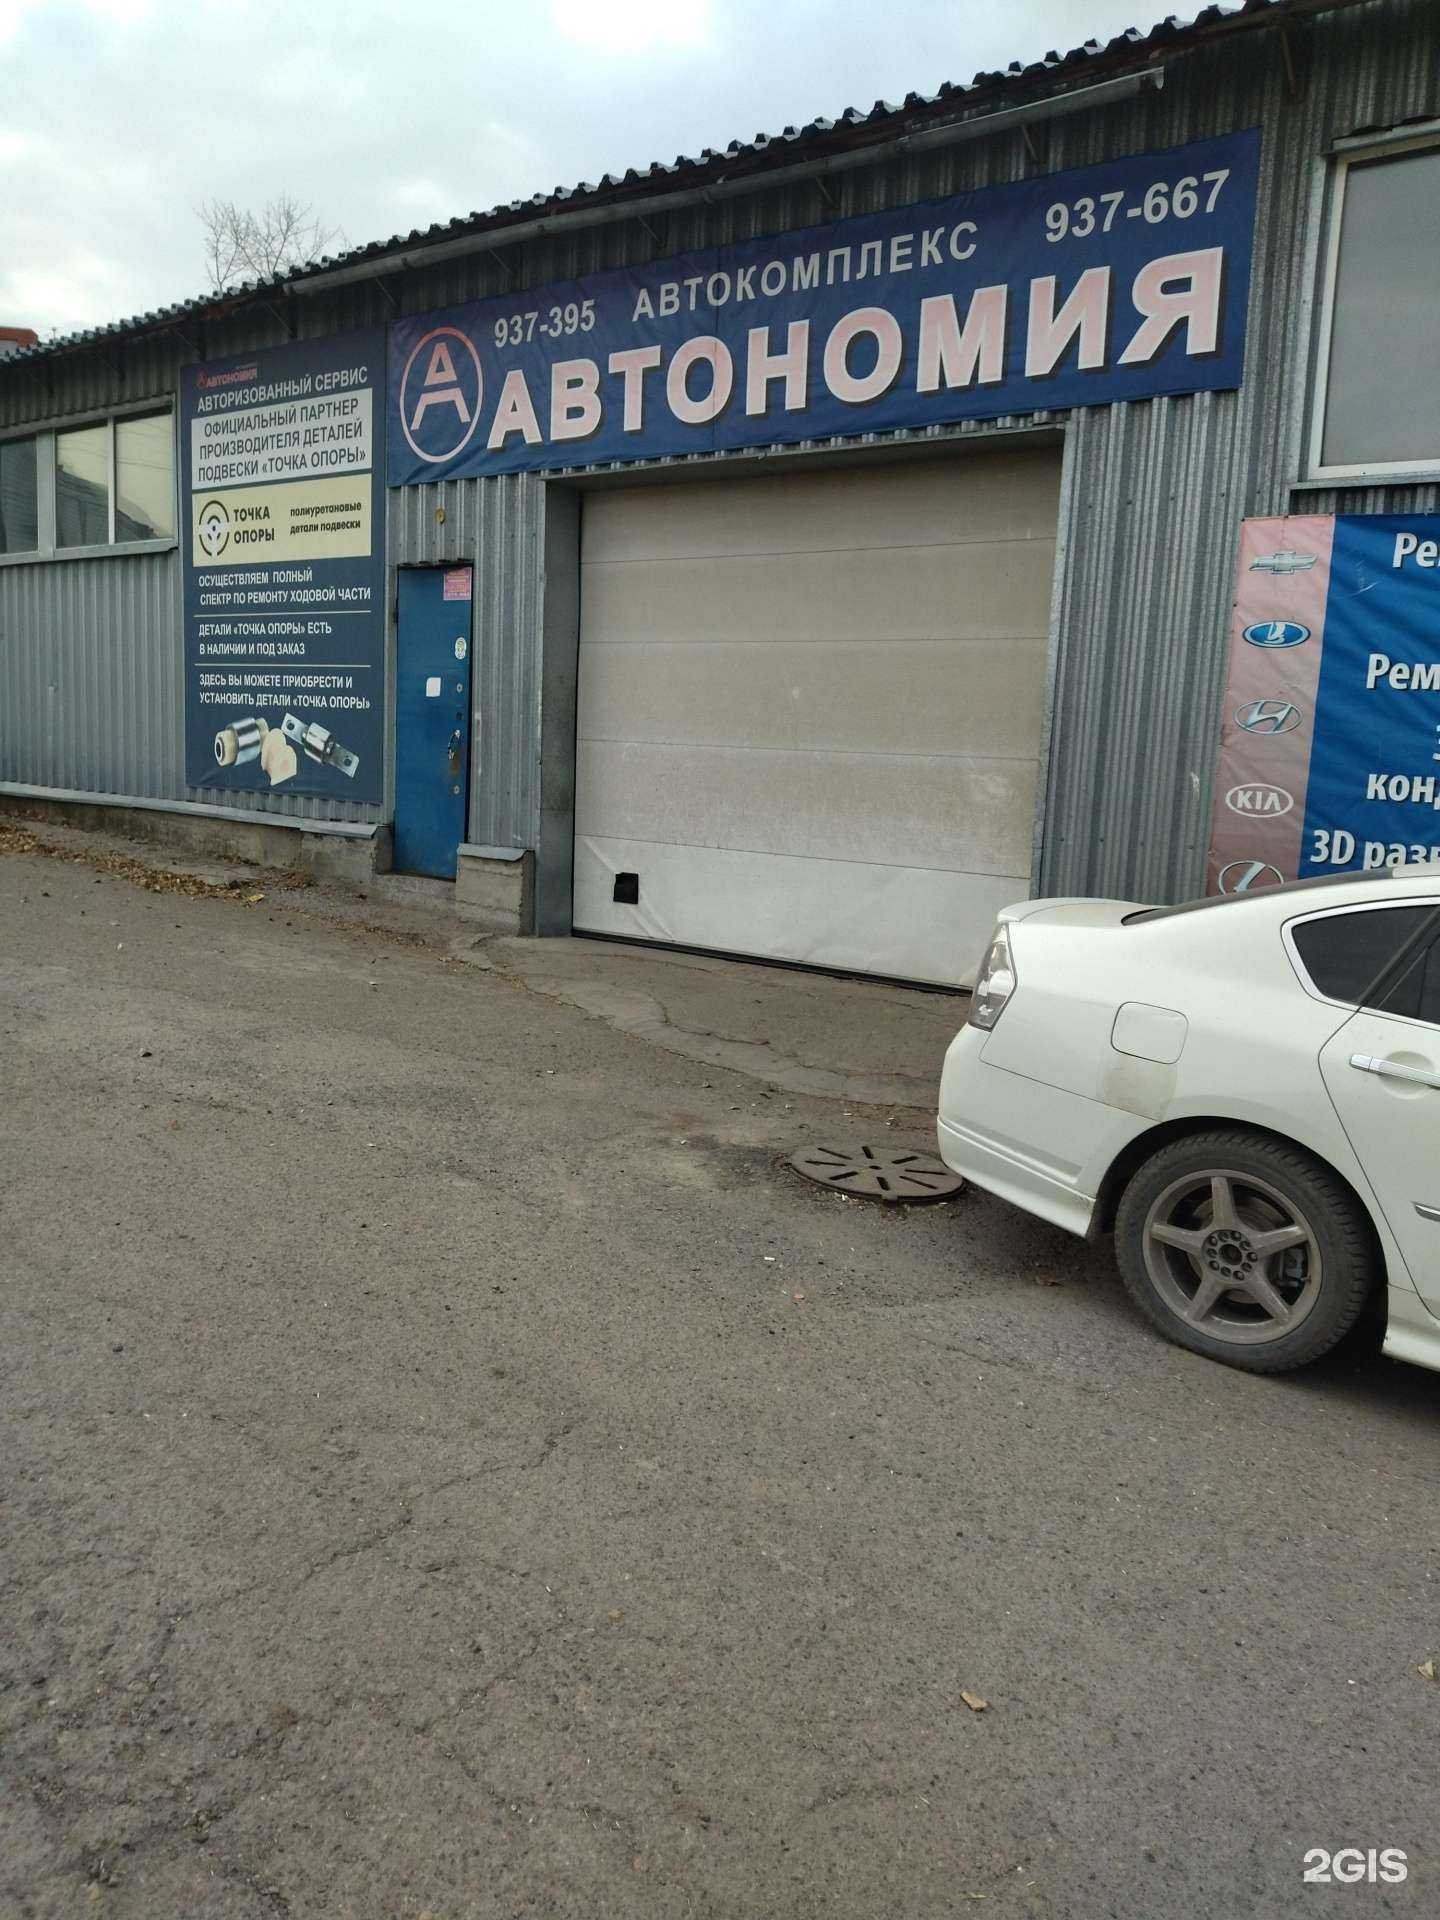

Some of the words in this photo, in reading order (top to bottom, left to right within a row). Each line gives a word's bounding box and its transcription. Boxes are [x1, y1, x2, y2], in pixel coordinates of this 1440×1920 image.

[1045, 168, 1230, 243] 937-667
[632, 221, 978, 322] АВТОКОМПЛЕКС
[494, 299, 595, 348] 937-395
[486, 246, 1223, 449] АВТОНОМИЯ
[197, 374, 312, 413] АВТОРИЗОВАННЫЙ
[315, 366, 368, 392] СЕРВИС
[204, 404, 296, 438] ОФИЦИАЛЬНЫЙ
[300, 398, 359, 422] ПАРТНЕР
[200, 433, 300, 460] ПРОИЗВОДИТЕЛЯ
[303, 418, 362, 445] ДЕТАЛЕЙ
[198, 460, 259, 482] ПОДВЕСКИ
[262, 453, 307, 473] «ТОЧКА
[311, 447, 367, 467] ОПОРЫ»
[233, 506, 271, 522] ТОЧКА
[320, 519, 361, 532] подвески
[233, 528, 275, 544] ОПОРЫ
[1392, 532, 1440, 568] Ре
[199, 571, 269, 588] ОСУЩЕСТВЛЯЕМ
[272, 566, 313, 583] ПОЛНЫЙ
[200, 591, 232, 605] СПЕКТР
[234, 591, 245, 604] ПО
[248, 589, 288, 604] РЕМОНТУ
[290, 586, 336, 603] ХОДОВОЙ
[338, 587, 371, 601] ЧАСТИ
[199, 623, 232, 637] ДЕТАЛИ
[233, 622, 266, 635] «ТОЧКА
[267, 622, 306, 635] ОПОРЫ»
[308, 621, 332, 634] ЕСТЬ
[199, 643, 205, 655] В
[207, 643, 247, 655] НАЛИЧИИ
[248, 643, 255, 655] И
[256, 643, 276, 656] ПОД
[277, 643, 305, 655] ЗАКАЗ
[199, 674, 227, 687] ЗДЕСЬ
[228, 674, 242, 686] ВЫ
[244, 674, 281, 687] МОЖЕТЕ
[283, 675, 344, 689] ПРИОБРЕСТИ
[345, 676, 353, 688] И
[199, 692, 255, 705] УСТАНОВИТЬ
[256, 694, 291, 707] ДЕТАЛИ
[293, 695, 327, 708] «ТОЧКА
[329, 696, 371, 710] ОПОРЫ»
[1236, 789, 1282, 812] KIA
[1367, 773, 1440, 810] кон
[1310, 829, 1355, 865] 3D
